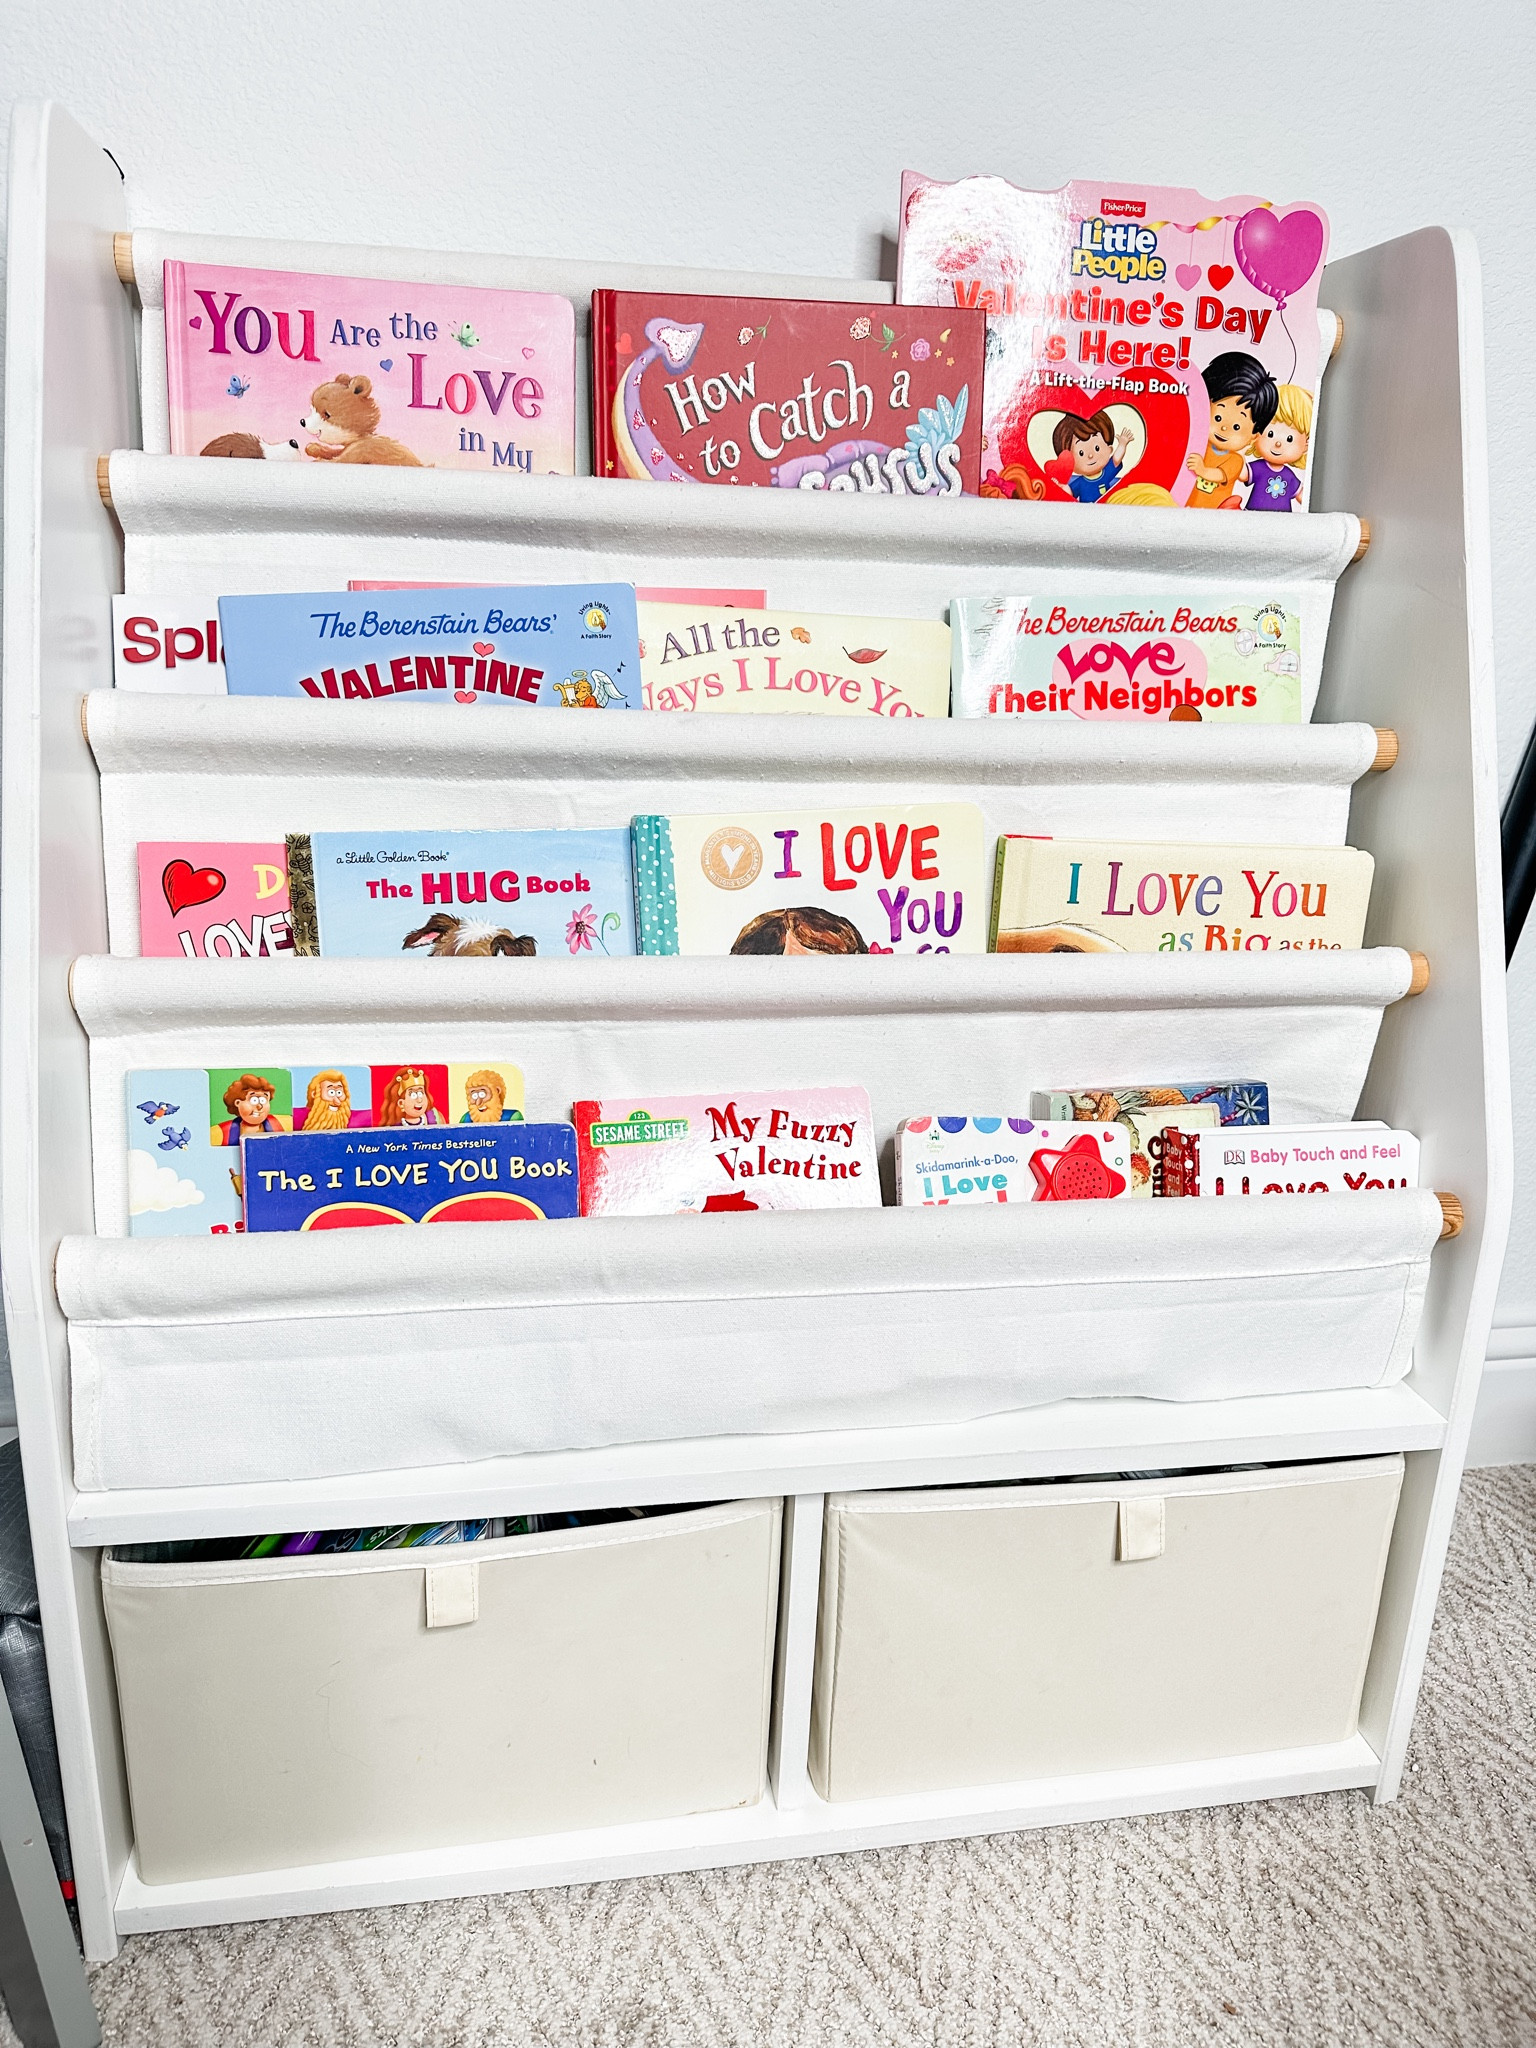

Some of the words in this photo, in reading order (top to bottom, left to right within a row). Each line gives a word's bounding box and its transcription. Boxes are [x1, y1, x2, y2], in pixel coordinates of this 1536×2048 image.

[1081, 218, 1156, 253] Little
[1071, 248, 1165, 282] People
[194, 289, 320, 362] You
[330, 319, 381, 347] Are
[389, 312, 439, 341] the
[952, 278, 1184, 329] Valentine's
[1195, 296, 1272, 345] Day
[1031, 326, 1067, 363] Is
[1079, 329, 1192, 370] Here!
[406, 352, 545, 419] Love
[664, 361, 757, 436] How
[1030, 371, 1041, 387] A
[1045, 371, 1145, 395] Lift-the-Flap
[1148, 379, 1189, 396] Book
[699, 435, 741, 477] to
[749, 360, 874, 461] Catch
[889, 370, 911, 411] a
[459, 427, 486, 452] in
[492, 441, 533, 473] My
[310, 610, 357, 639] The
[359, 610, 479, 638] Berenstain
[484, 608, 557, 634] Bears'
[1045, 606, 1165, 634] Berenstain
[1170, 607, 1237, 633] Bears
[660, 623, 717, 665] All
[722, 618, 780, 650] the
[299, 654, 544, 704] VALENTINE
[733, 657, 753, 692] I
[764, 656, 861, 704] Love
[988, 682, 1075, 713] Their
[1083, 677, 1258, 715] Neighbors
[336, 856, 344, 864] a
[345, 851, 376, 864] Little
[376, 850, 417, 864] Golden
[418, 850, 448, 863] Book
[773, 829, 801, 879] I
[820, 822, 940, 892] LOVE
[366, 878, 414, 899] The
[421, 870, 521, 905] HUG
[526, 873, 591, 895] Book
[1066, 862, 1082, 905] I
[1101, 861, 1223, 917] Love
[1241, 870, 1327, 919] You
[877, 886, 963, 943] YOU
[1158, 932, 1193, 951] as
[595, 1124, 641, 1143] SESAME
[644, 1121, 685, 1140] STREET
[633, 1112, 646, 1120] 123
[705, 1101, 762, 1143] My
[767, 1108, 858, 1148] Fuzzy
[345, 1144, 354, 1154] A
[357, 1144, 380, 1153] New
[384, 1142, 408, 1153] York
[412, 1141, 443, 1150] Times
[445, 1139, 497, 1149] Bestseller
[715, 1145, 863, 1181] Valentine
[915, 1153, 1019, 1174] Skidamarink-a-Doo,
[1166, 1143, 1182, 1159] Baby
[1226, 1150, 1244, 1163] DK
[1250, 1148, 1288, 1165] Baby
[1293, 1146, 1335, 1162] Touch
[1340, 1145, 1367, 1159] and
[1372, 1144, 1401, 1159] Feel
[258, 1169, 316, 1192] The
[326, 1167, 343, 1189] I
[355, 1162, 429, 1187] LOVE
[439, 1158, 499, 1183] YOU
[510, 1156, 573, 1179] Book
[923, 1177, 933, 1198] I
[942, 1173, 1008, 1196] Love
[1168, 1174, 1180, 1185] and
